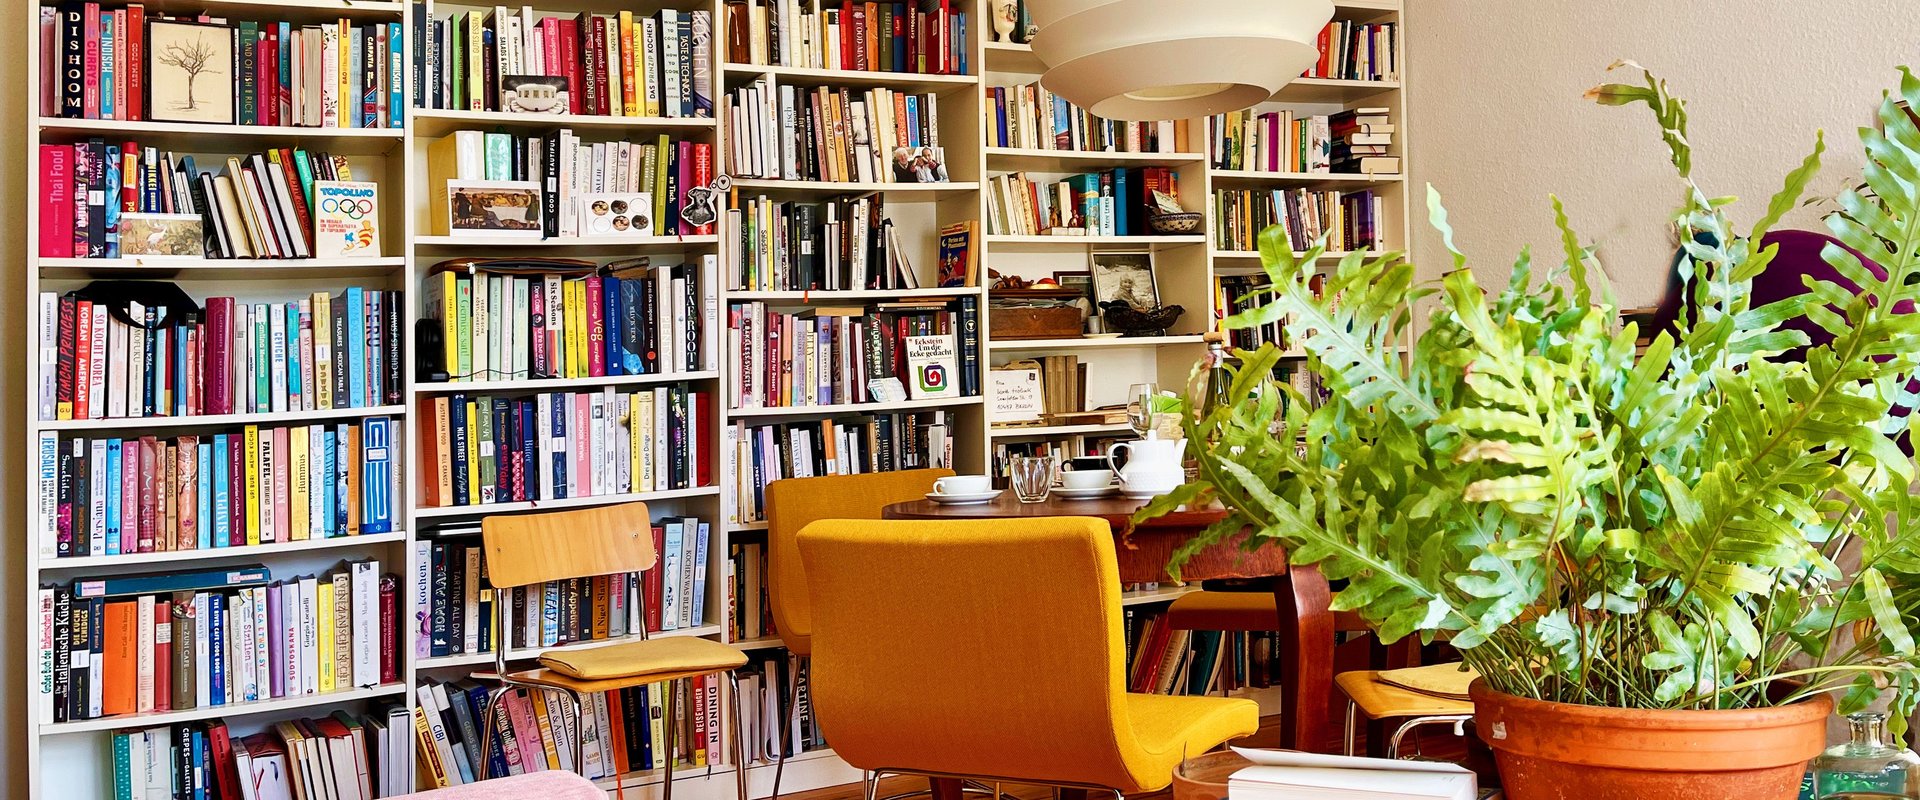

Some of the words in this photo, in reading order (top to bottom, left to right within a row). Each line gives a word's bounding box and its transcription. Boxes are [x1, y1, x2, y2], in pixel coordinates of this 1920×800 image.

[68, 12, 81, 108] DISHOOM
[102, 38, 112, 72] INDISCH
[472, 38, 480, 54] GUTES
[693, 16, 706, 78] KOCHEN
[87, 41, 96, 86] CURRYS
[245, 59, 252, 69] OF
[586, 50, 594, 99] EINGEMACHT
[681, 61, 690, 102] TECHNIQUE
[50, 151, 64, 176] Food
[148, 165, 156, 190] NIKKEI
[50, 179, 63, 203] Thai
[320, 188, 374, 197] TOPOLINO
[60, 300, 73, 357] PRINCESS
[80, 307, 89, 341] KOREAN
[94, 314, 104, 326] SO
[258, 321, 266, 348] Cantina
[366, 303, 380, 347] PERU
[590, 320, 603, 341] veg
[93, 328, 104, 355] KOCHT
[275, 332, 283, 362] CEVICHE
[304, 336, 310, 346] MY
[909, 351, 926, 359] Ecke
[927, 349, 952, 358] gedacht
[60, 360, 72, 402] KIMCHI
[78, 358, 86, 402] AMERICAN
[92, 358, 103, 386] KOREA
[319, 364, 328, 406] OAXACA
[42, 437, 54, 479] JERUSALEM
[525, 440, 533, 463] Bitter
[62, 455, 71, 499] Snackistan
[298, 454, 307, 493] Hummus
[92, 501, 103, 539] Persiana
[217, 491, 227, 533] SIMPLY
[417, 562, 428, 605] kochen.
[453, 570, 461, 605] TARTINE
[597, 576, 606, 602] Slater
[55, 594, 69, 625] Küche
[72, 610, 80, 634] KÜCHE
[337, 583, 348, 651] VENEZIANISCHE
[436, 599, 446, 632] HOME
[453, 607, 461, 621] ALL
[545, 599, 557, 622] EASY
[569, 592, 578, 629] Appetite
[598, 605, 608, 627] Nigel
[681, 597, 689, 622] BLEIBT
[41, 614, 53, 649] Italienischen
[244, 625, 252, 661] Sizilien
[303, 623, 311, 647] Giorgio
[42, 651, 52, 659] der
[42, 661, 52, 674] Buch
[55, 628, 69, 683] italienische
[288, 628, 296, 680] SÜDTOSKANA
[338, 654, 348, 684] KÜCHE
[42, 675, 53, 694] Großes
[798, 669, 808, 721] TARTINE
[695, 688, 704, 733] REISEHUNGER
[709, 687, 718, 729] DINING
[433, 724, 445, 741] CIBI
[495, 704, 508, 730] CARAVAN
[502, 731, 513, 752] DINING
[553, 723, 564, 747] Again
[709, 732, 718, 743] IN
